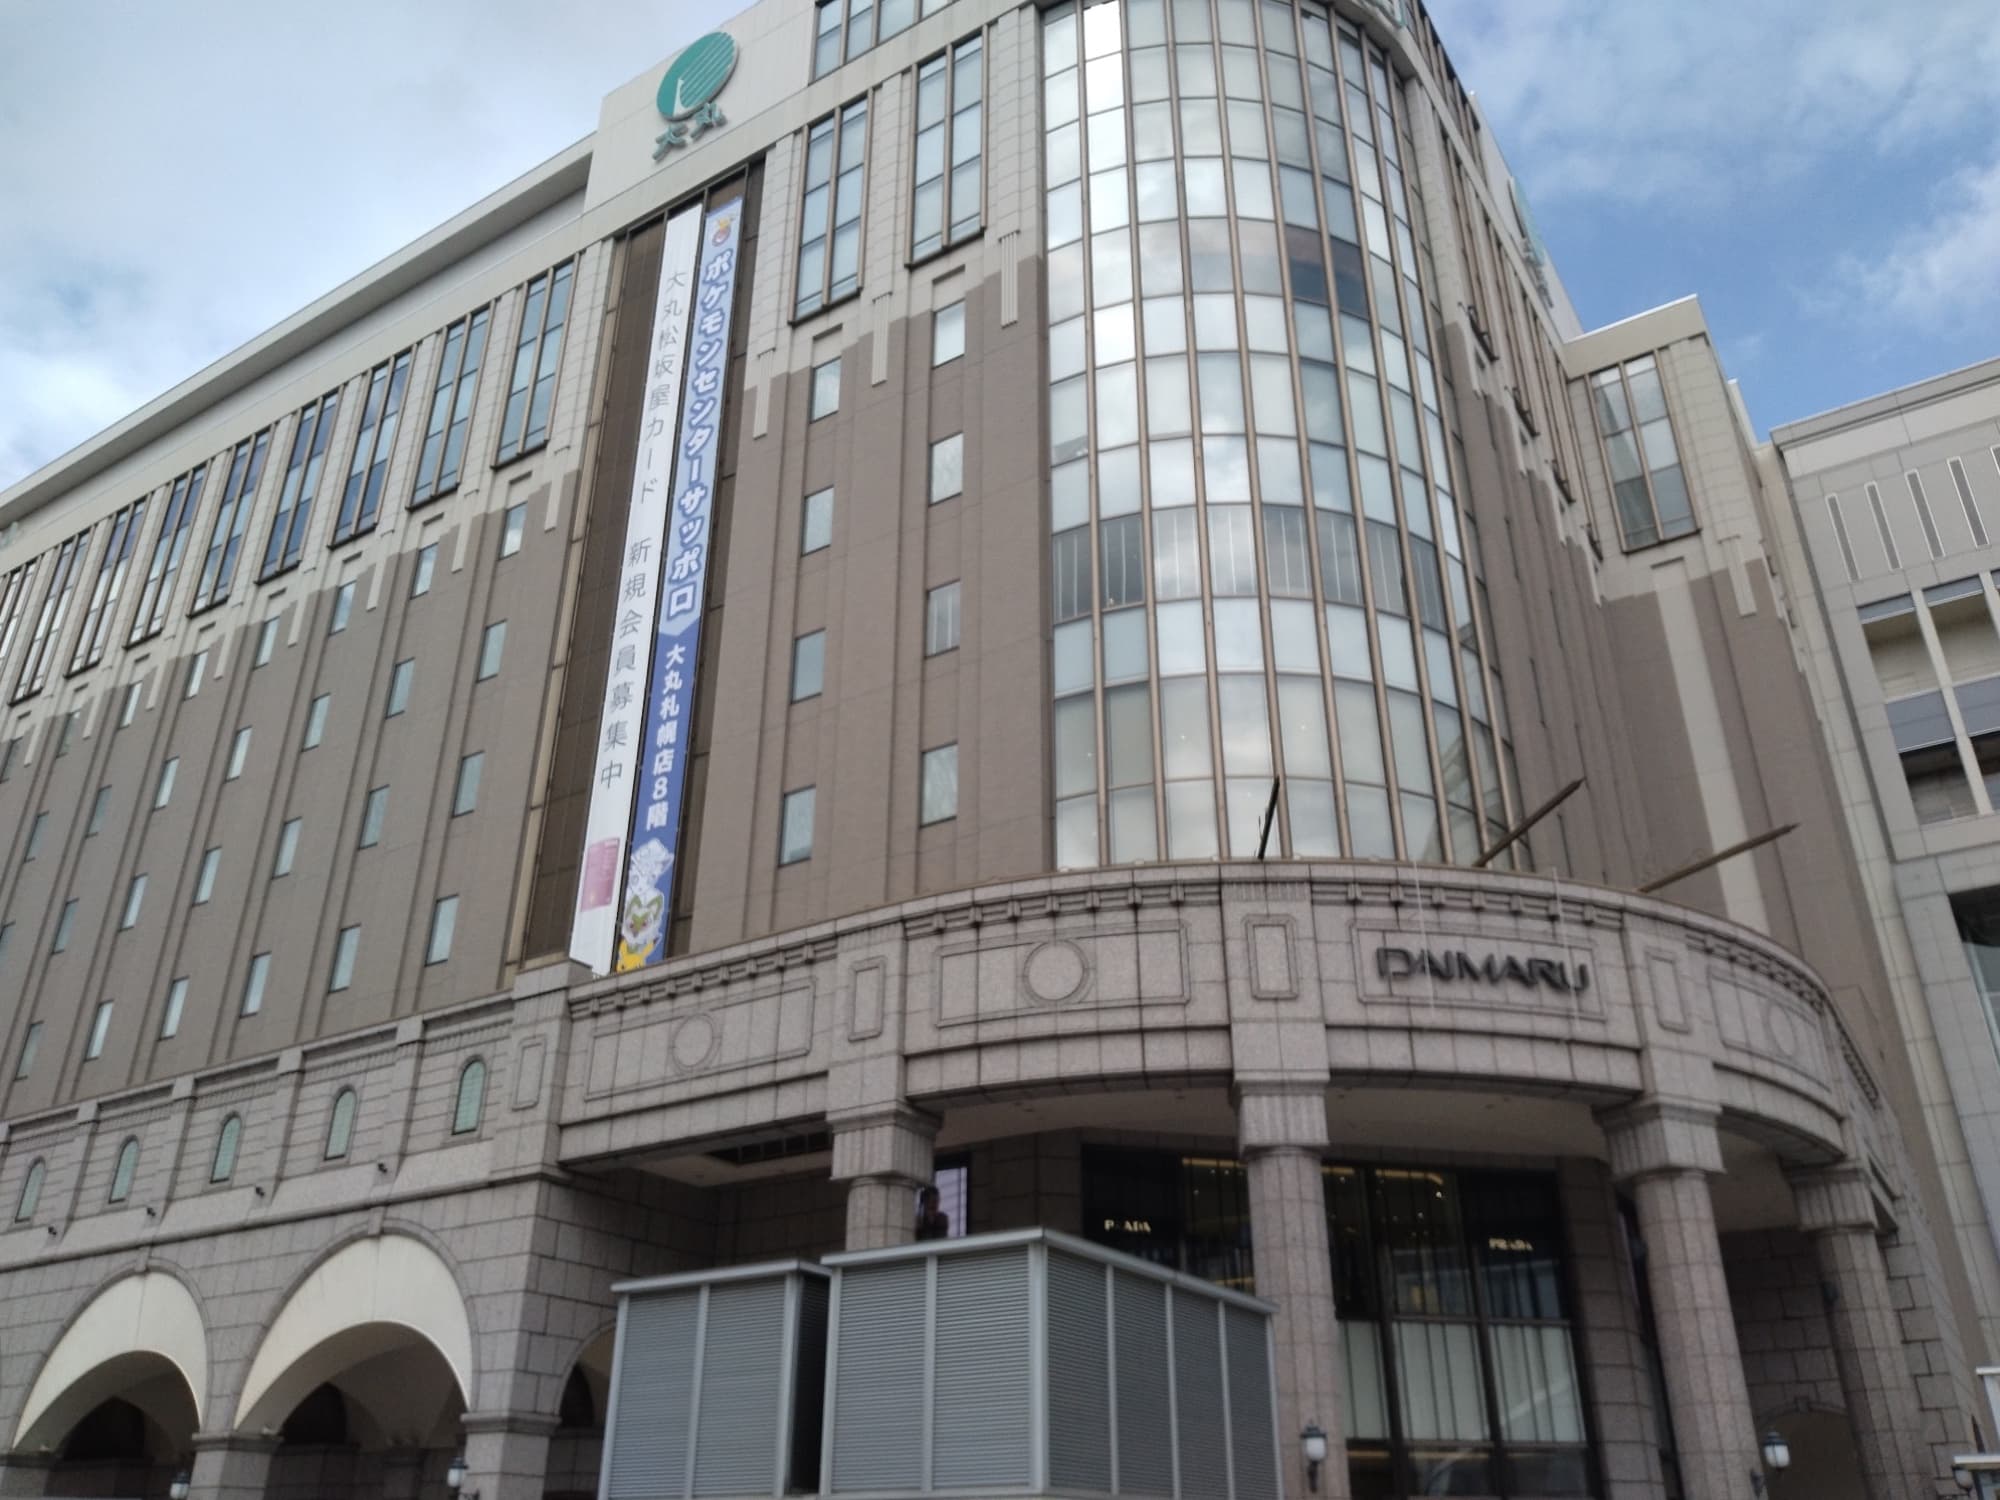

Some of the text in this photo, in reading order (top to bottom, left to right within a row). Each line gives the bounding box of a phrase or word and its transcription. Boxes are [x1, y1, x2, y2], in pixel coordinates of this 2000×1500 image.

[668, 250, 732, 616] ポケモンセンターサッポロ
[600, 537, 652, 790] 新規会員募集中
[646, 643, 686, 832] 大丸札幌店8階
